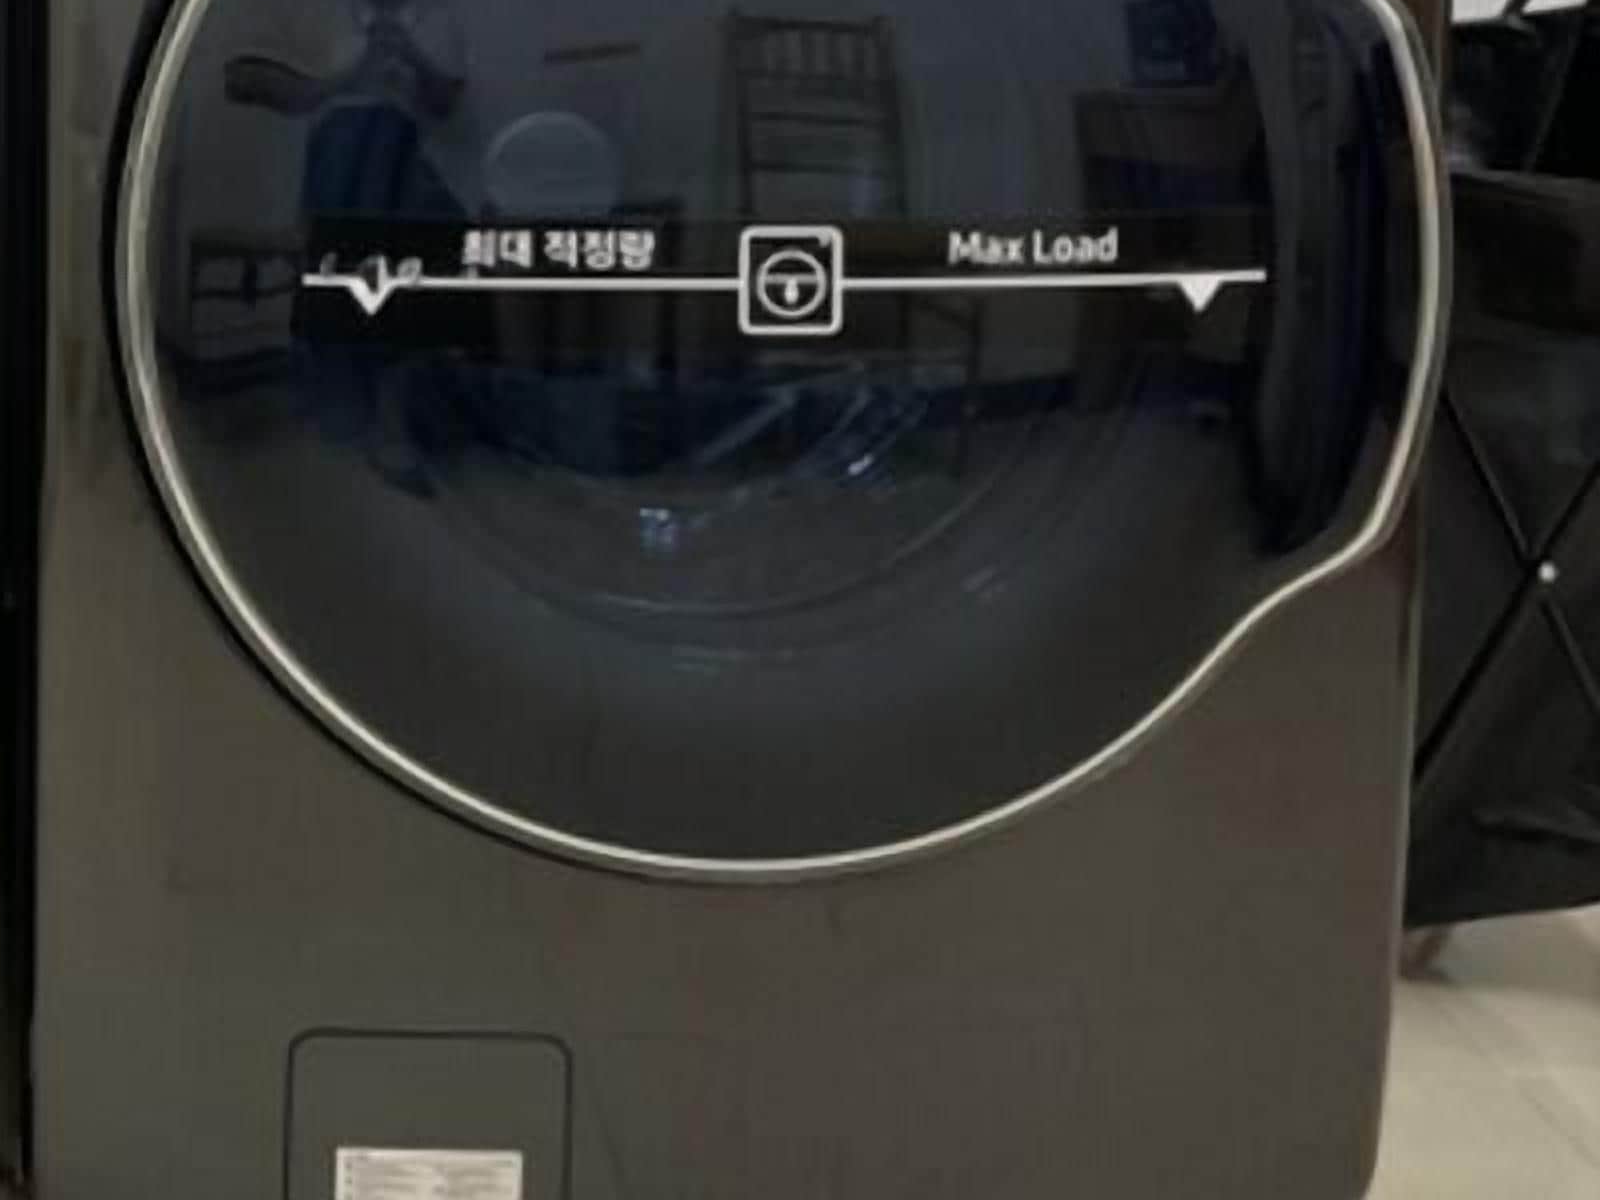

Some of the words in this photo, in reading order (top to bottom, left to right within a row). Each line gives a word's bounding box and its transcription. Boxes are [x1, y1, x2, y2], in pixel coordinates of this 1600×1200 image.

[461, 229, 532, 268] 최대
[543, 229, 656, 272] 적정량
[948, 230, 1025, 266] Max
[1032, 226, 1119, 265] Load
